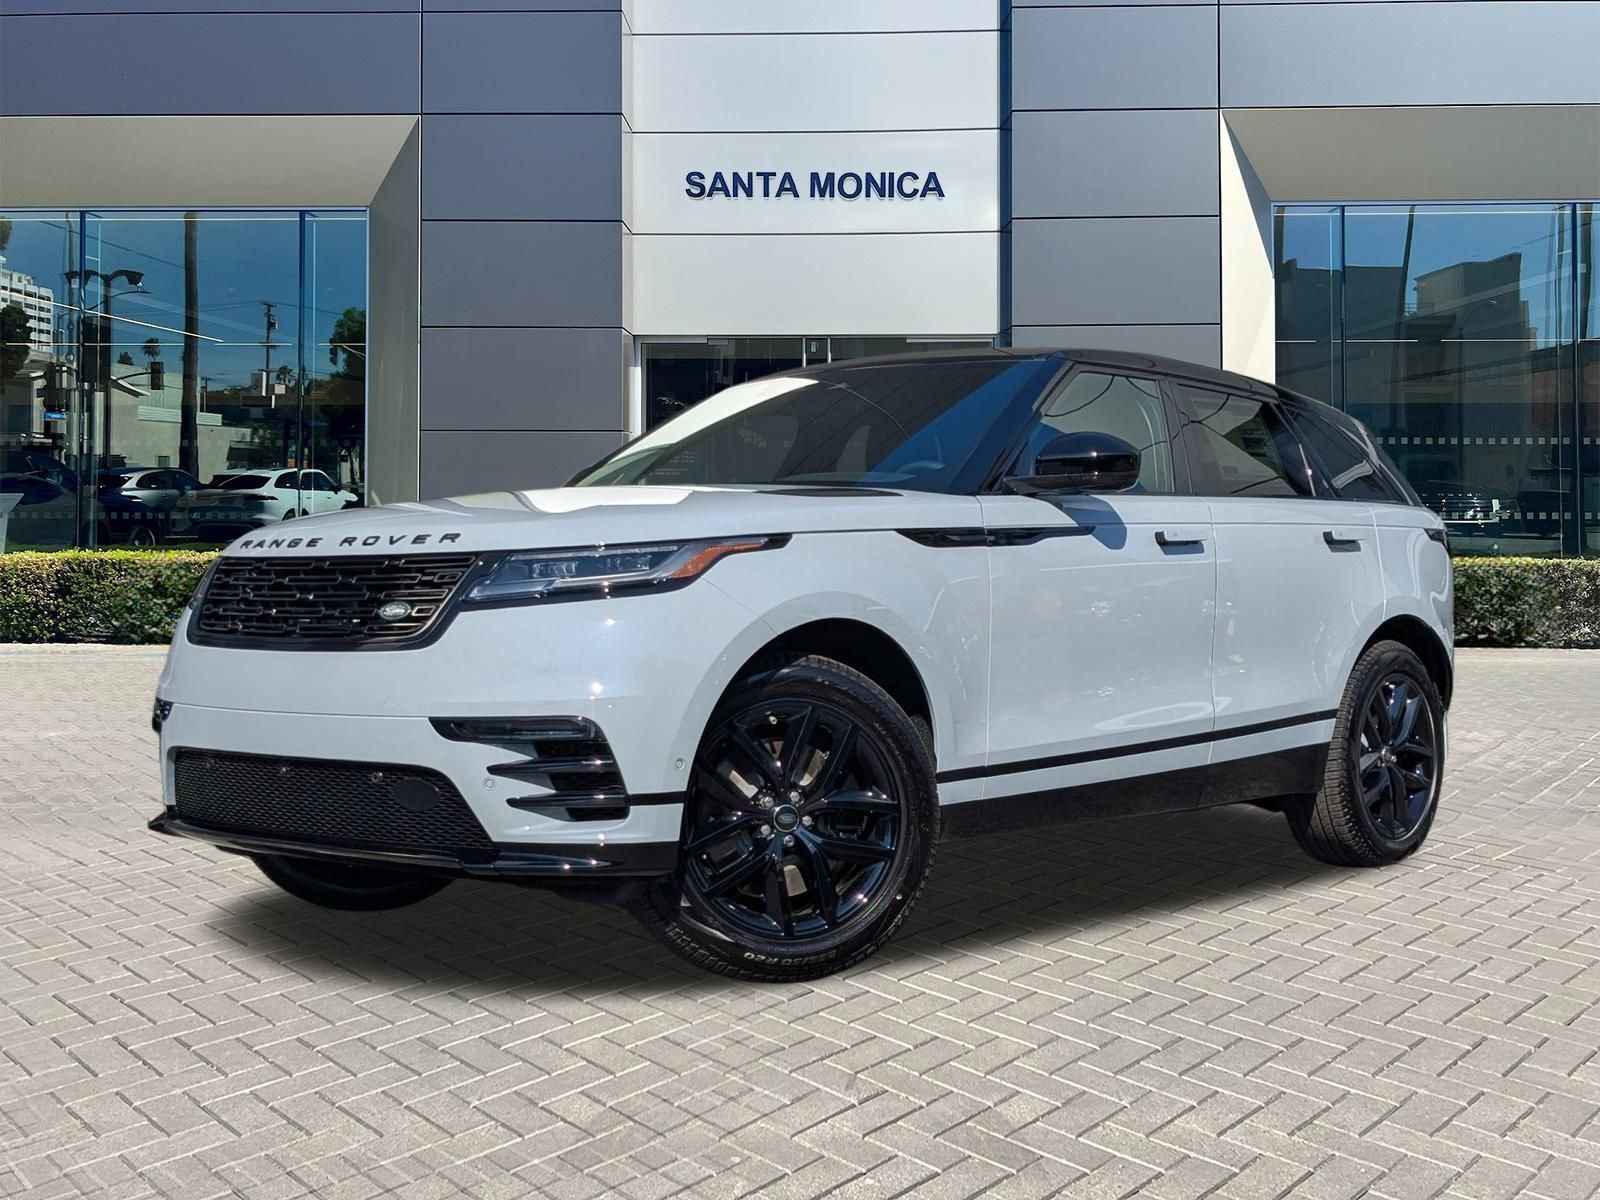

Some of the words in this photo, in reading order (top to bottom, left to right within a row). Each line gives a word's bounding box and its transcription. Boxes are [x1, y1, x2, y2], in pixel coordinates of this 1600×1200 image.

[685, 171, 800, 198] SANTA
[809, 171, 945, 199] MONICA
[240, 537, 323, 549] RANGE
[338, 532, 462, 547] ROVER
